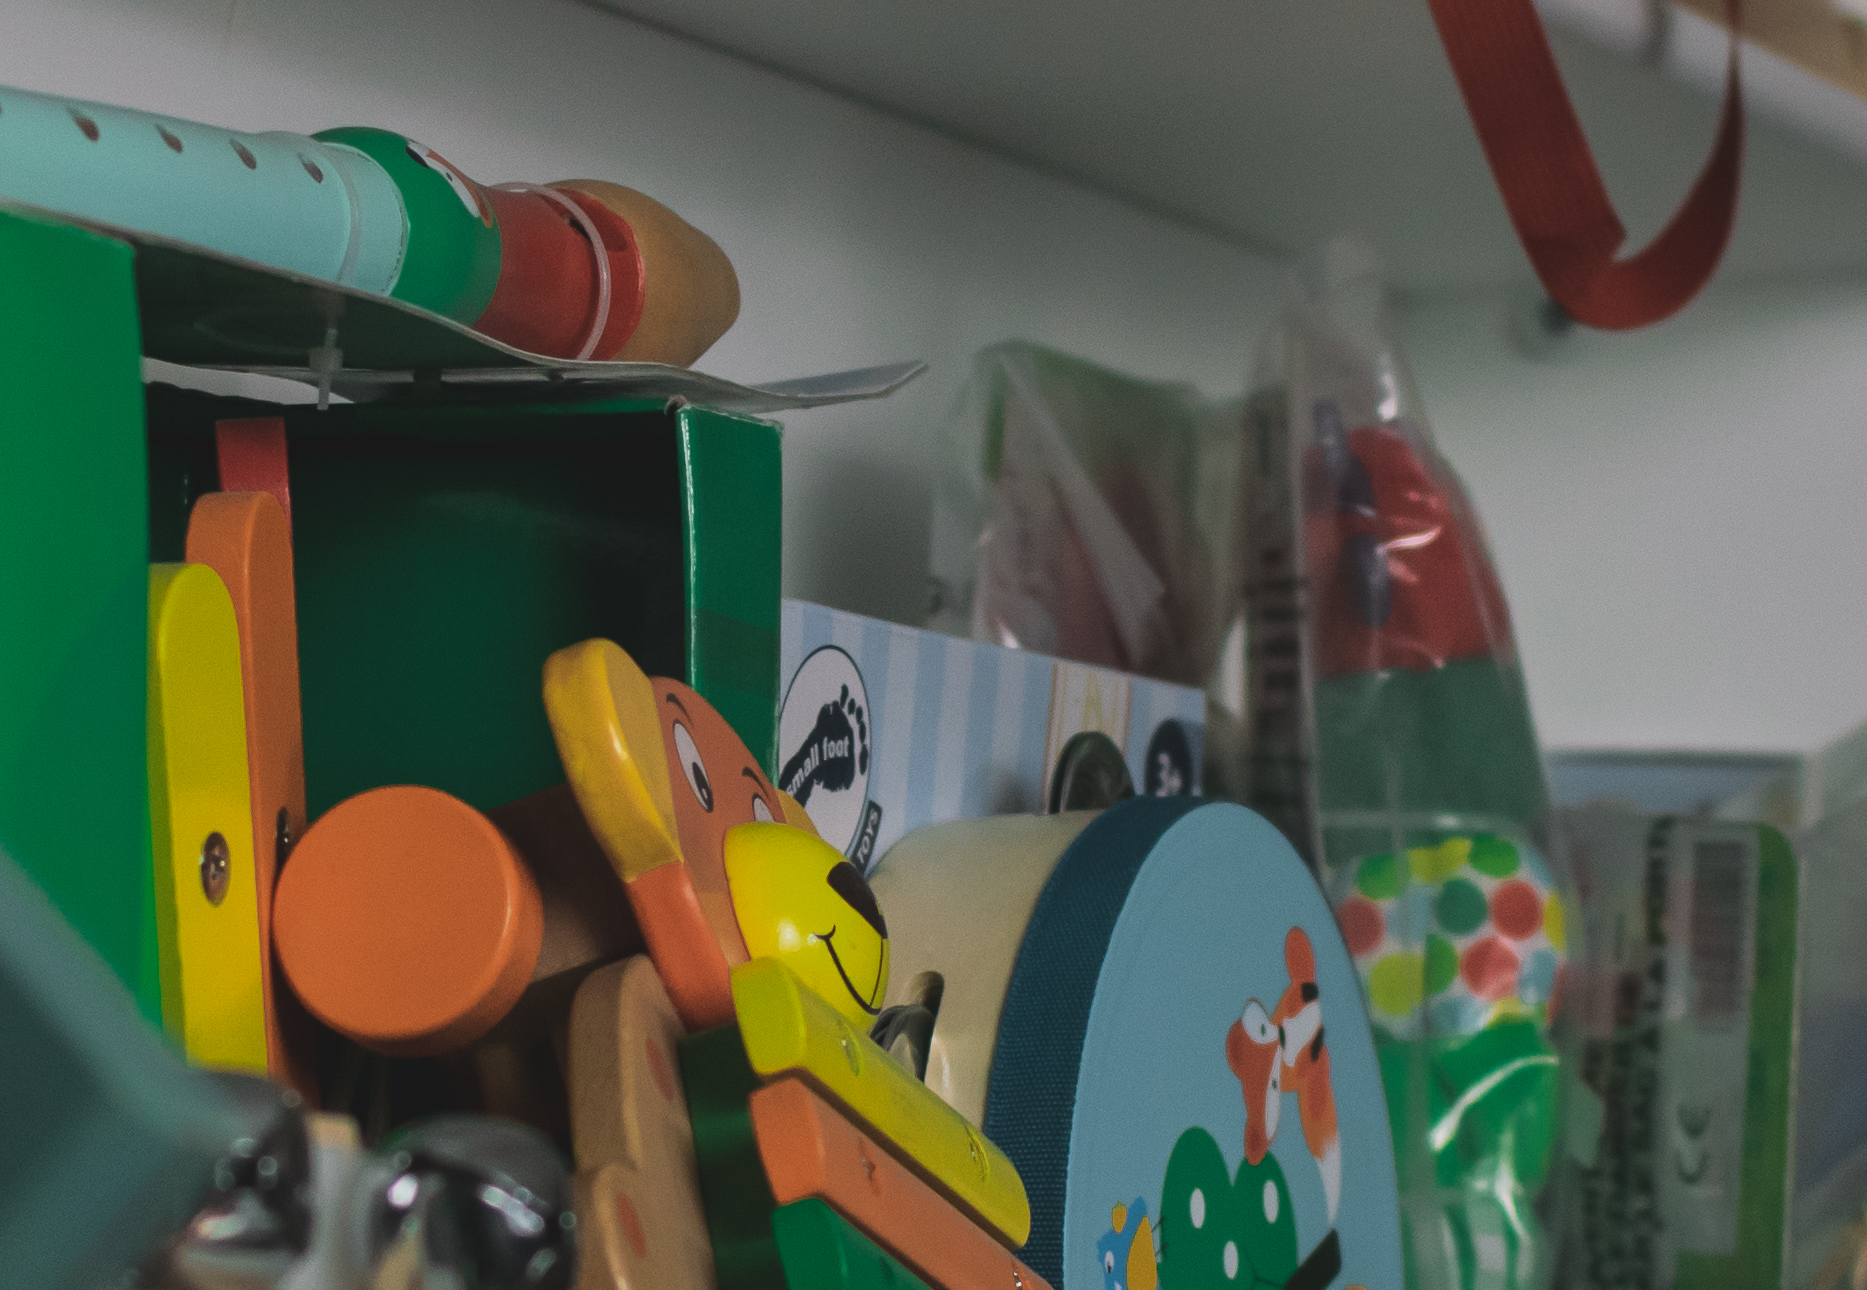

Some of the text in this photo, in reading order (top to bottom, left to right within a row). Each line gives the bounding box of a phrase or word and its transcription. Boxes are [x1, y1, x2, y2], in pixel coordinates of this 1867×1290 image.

[785, 734, 852, 798] small foot
[856, 807, 882, 865] TOYS
